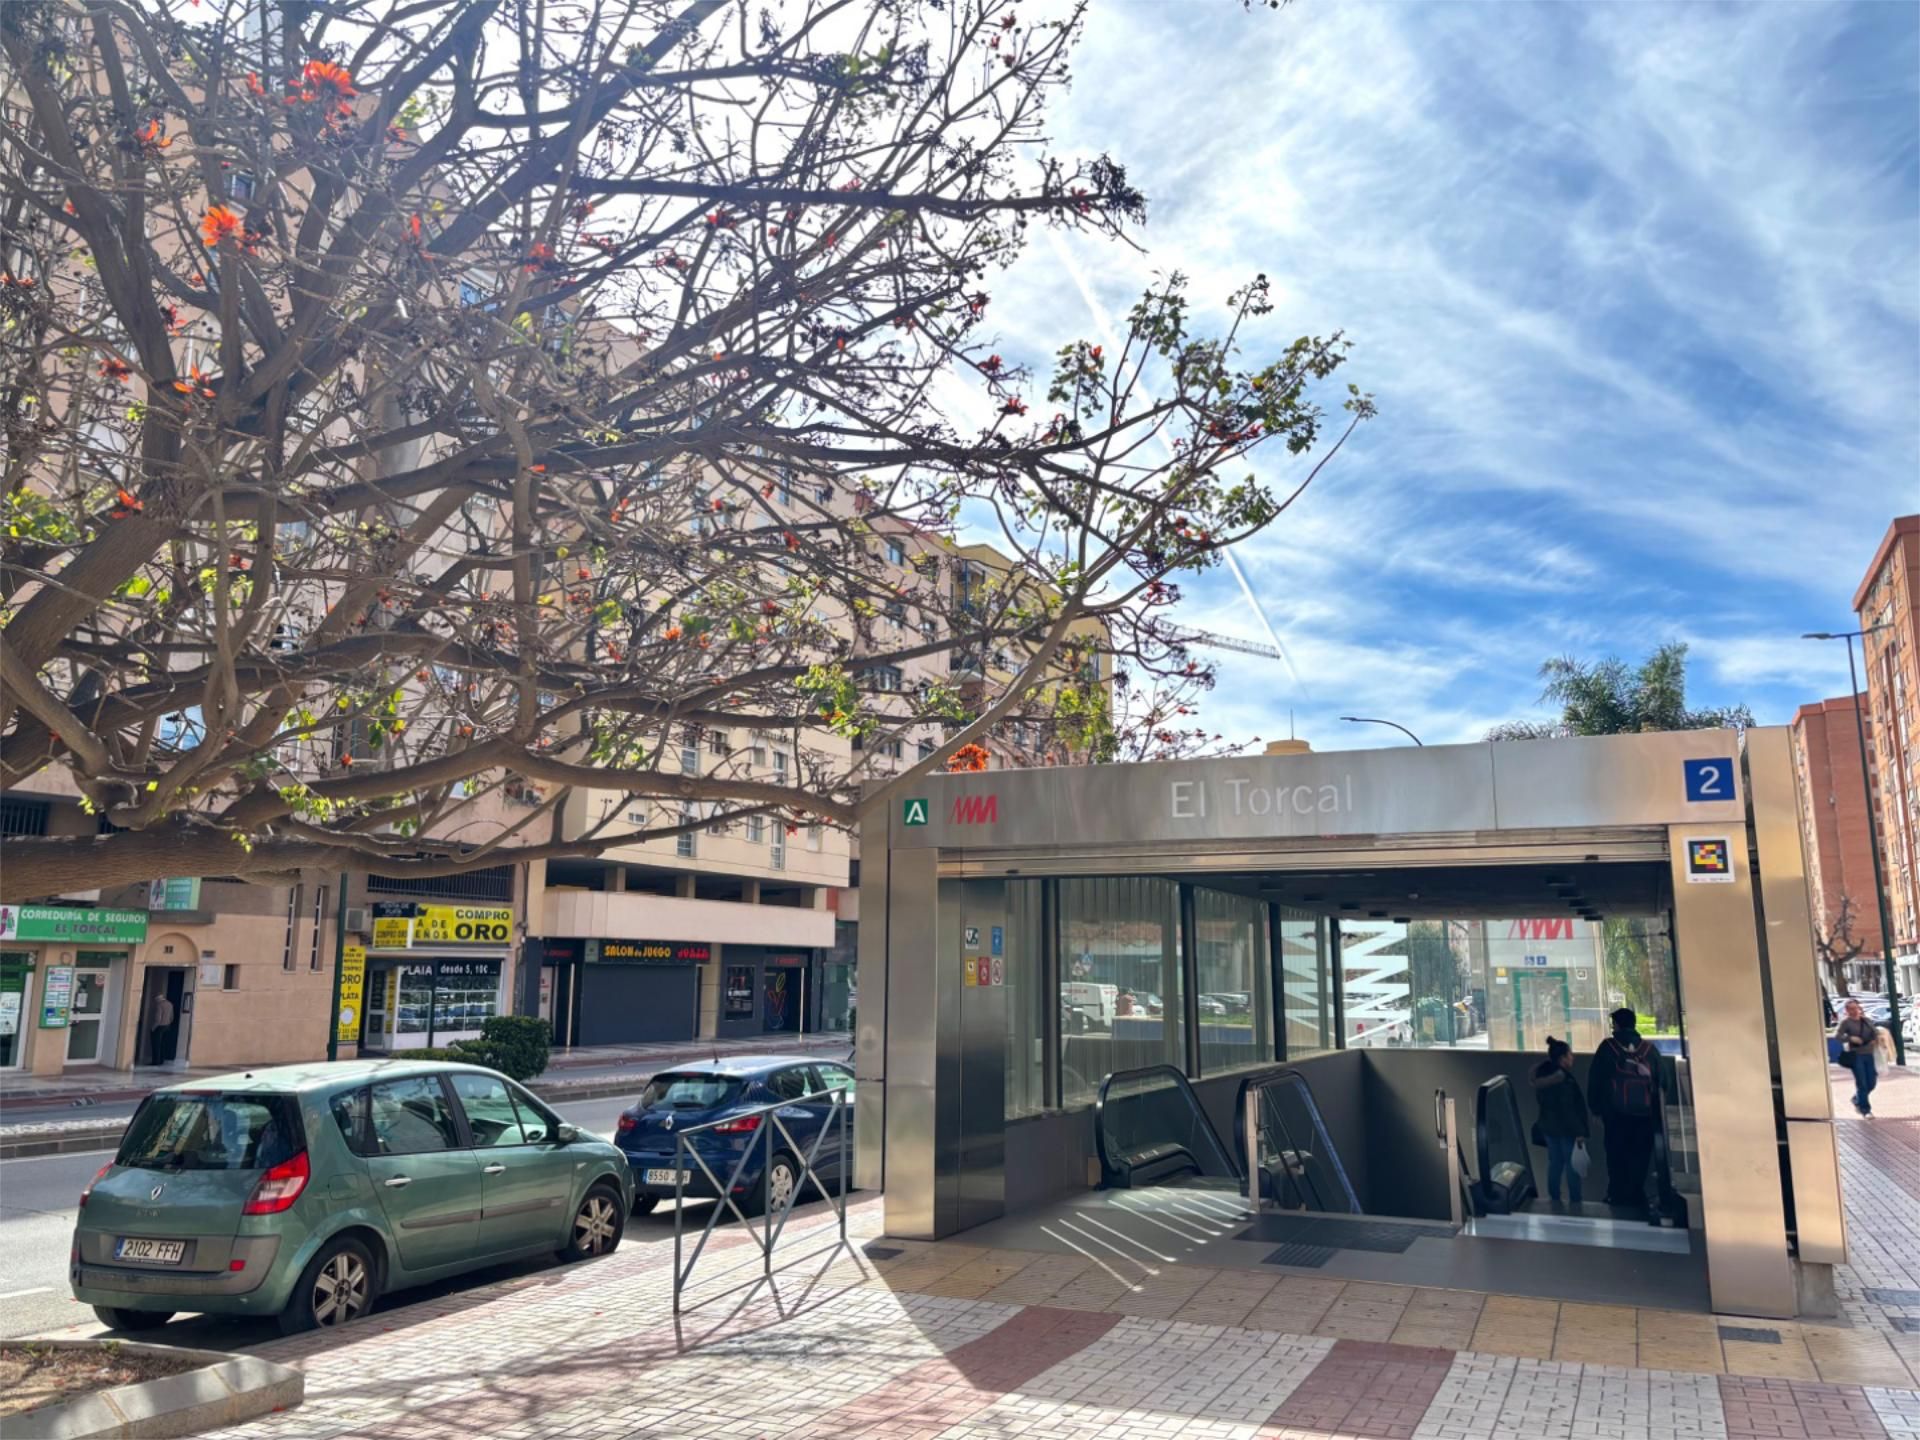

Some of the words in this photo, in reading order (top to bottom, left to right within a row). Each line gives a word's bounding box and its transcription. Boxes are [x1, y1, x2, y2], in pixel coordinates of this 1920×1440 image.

[1699, 766, 1721, 794] 2
[1171, 780, 1206, 818] El
[1223, 774, 1353, 816] Torcal
[906, 801, 926, 824] A
[21, 909, 82, 920] CORREDURÍA
[88, 912, 100, 921] DE
[106, 913, 146, 924] SEGUROS
[455, 909, 510, 921] COMPRO
[55, 924, 67, 933] EL
[73, 924, 116, 934] TORCAL
[432, 919, 446, 928] DE
[415, 930, 449, 939] EÑOS
[455, 923, 508, 940] ORO
[604, 945, 634, 957] SALON
[643, 946, 671, 958] JUEGO
[440, 964, 463, 973] desde
[340, 992, 358, 1000] LATA
[124, 1240, 153, 1257] 2102
[155, 1242, 181, 1259] FFH
